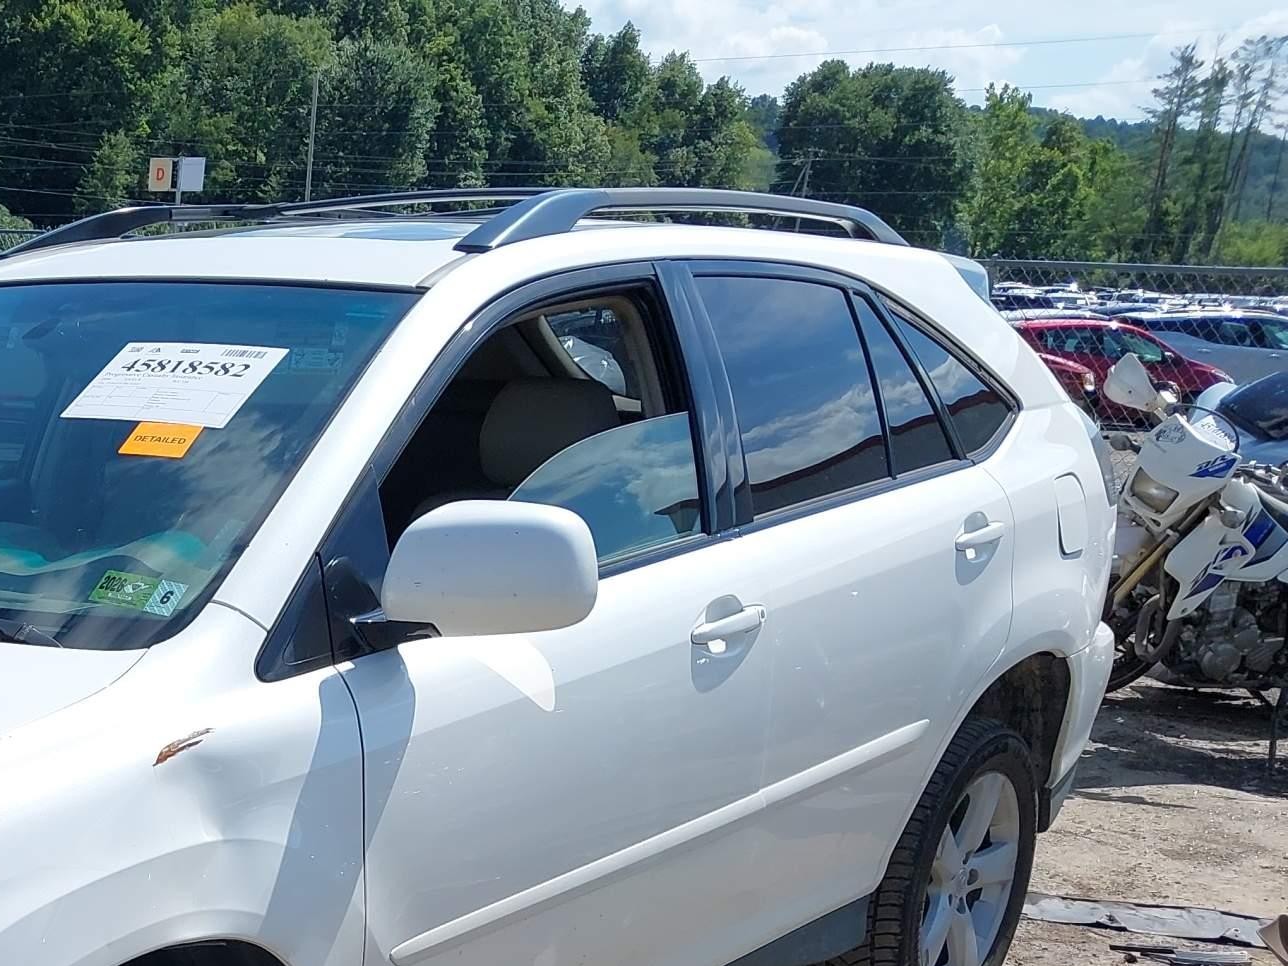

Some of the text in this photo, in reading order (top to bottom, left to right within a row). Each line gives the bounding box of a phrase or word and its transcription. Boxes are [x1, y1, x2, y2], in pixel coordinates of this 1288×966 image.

[156, 167, 165, 181] D
[120, 358, 252, 378] 45818582
[133, 434, 187, 445] DETAILED
[159, 590, 175, 605] 6
